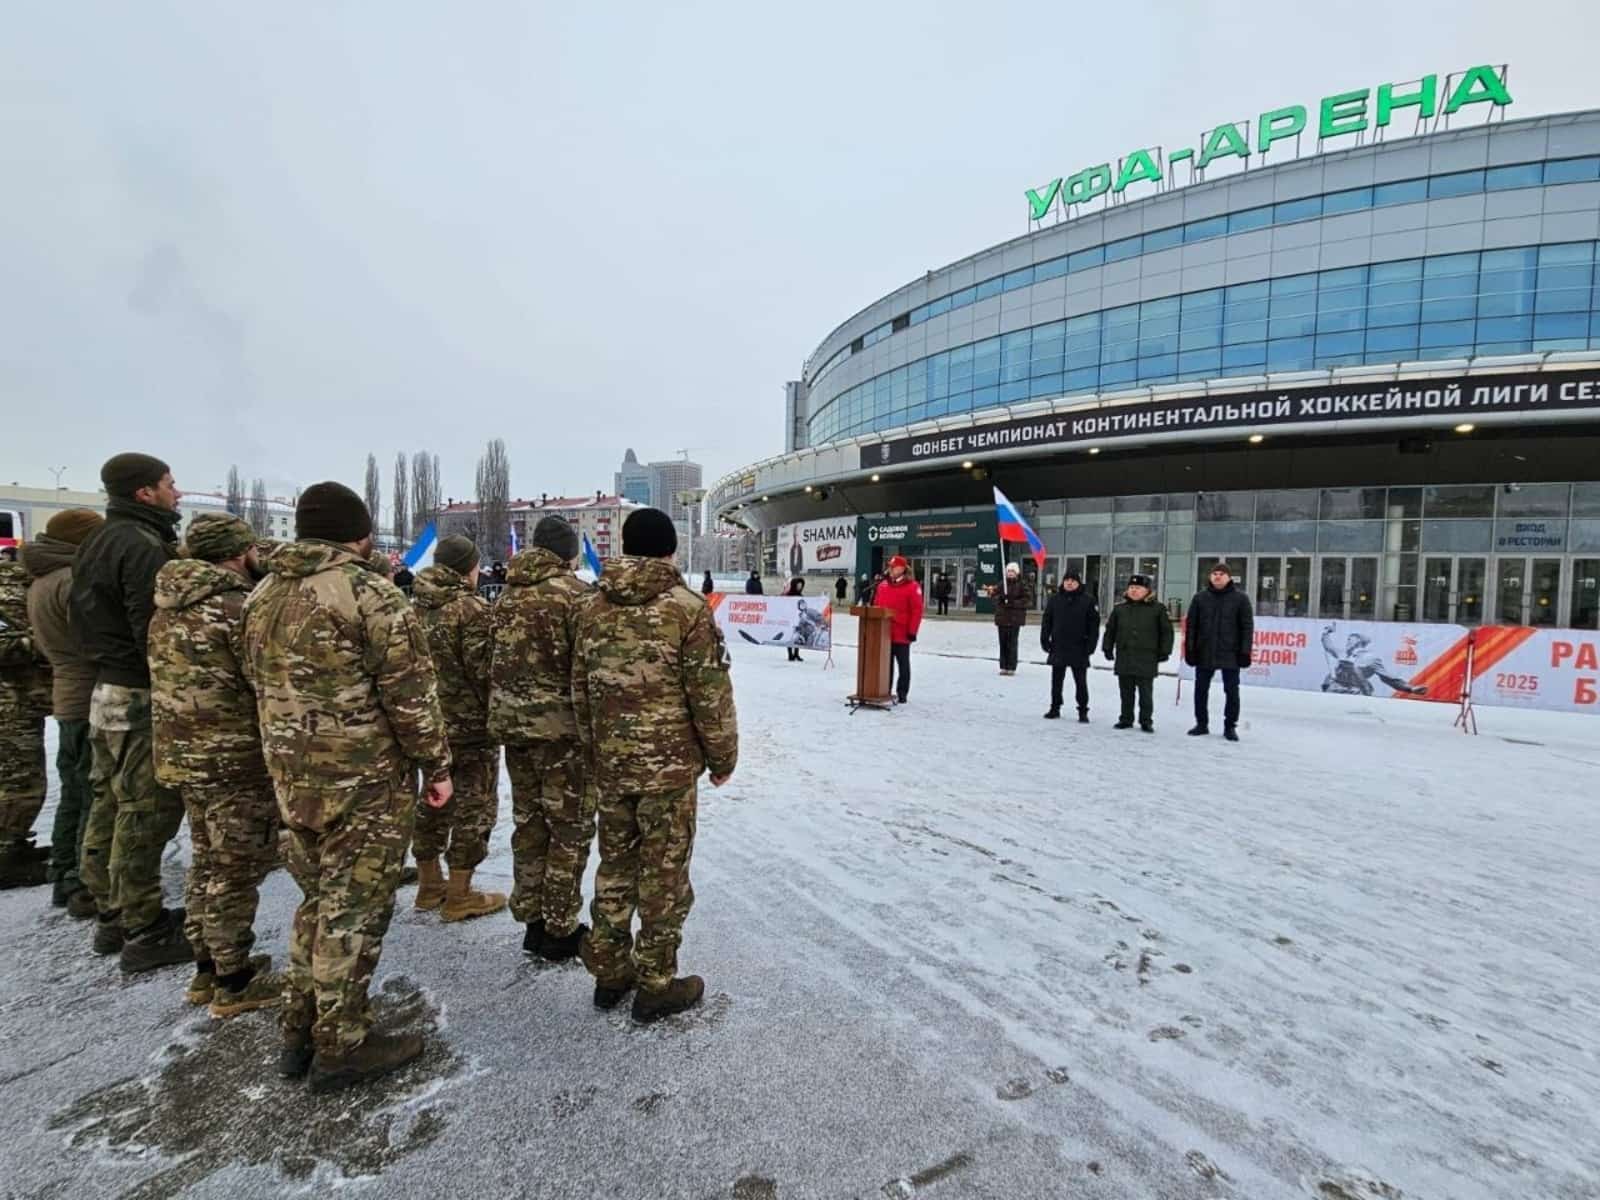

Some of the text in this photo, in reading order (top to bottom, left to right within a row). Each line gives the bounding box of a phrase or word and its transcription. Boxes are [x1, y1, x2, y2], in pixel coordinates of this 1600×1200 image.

[1025, 64, 1513, 220] УФА-АРЕНА
[911, 438, 965, 457] ФОНБЕТ
[968, 422, 1067, 448] ЧЕМПИОНАТ
[1073, 396, 1291, 435] КОНТИНЕНТАЛЬНОЙ
[1299, 384, 1462, 415] ХОККЕЙНОЙ
[1470, 382, 1549, 406] ЛИГИ
[802, 525, 857, 543] SHAMAN
[1496, 673, 1538, 690] 2025
